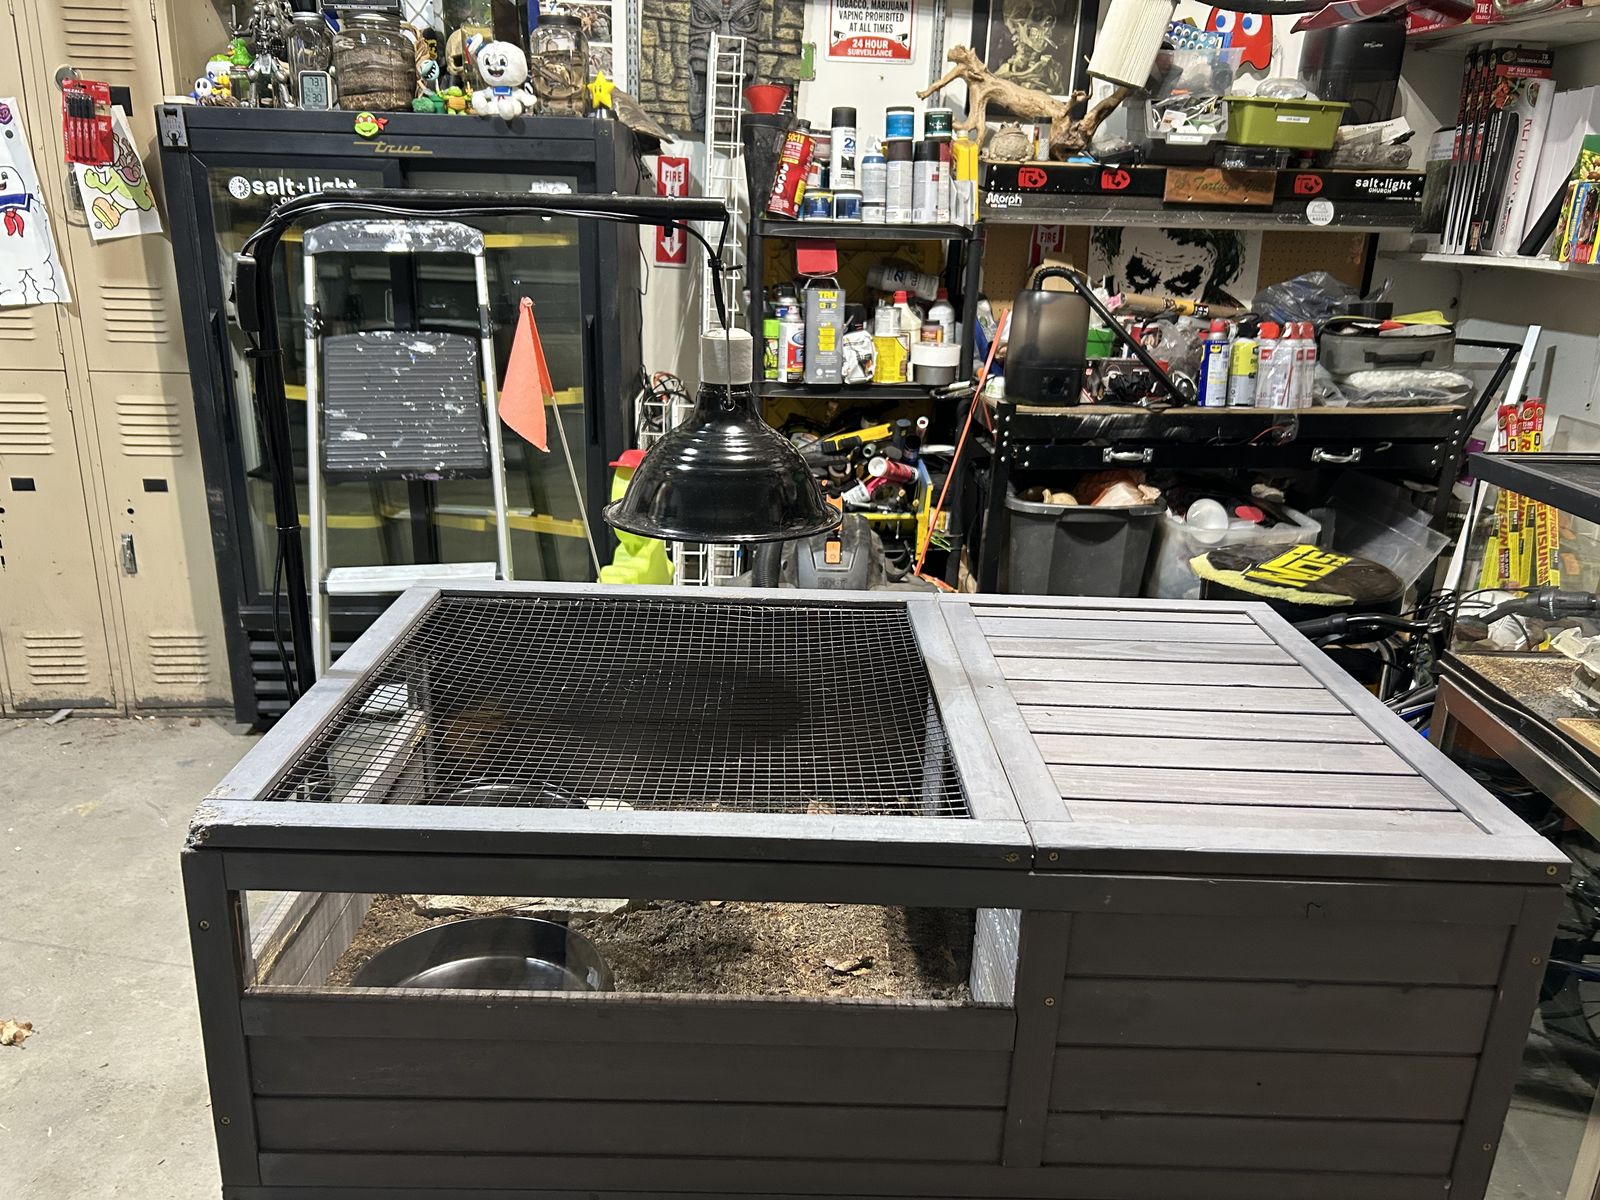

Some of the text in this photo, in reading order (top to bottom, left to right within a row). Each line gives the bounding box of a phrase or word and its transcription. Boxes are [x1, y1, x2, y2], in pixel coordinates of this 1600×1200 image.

[836, 0, 909, 11] TOBACCO, MARIJUANA
[839, 10, 905, 22] VAPING PROHIBITED
[849, 22, 894, 33] AT ALL TIMES
[852, 39, 889, 49] 24 HOUR
[847, 48, 893, 57] SURVEILLANCE
[665, 171, 682, 181] FIRE
[986, 193, 1022, 206] Morph
[1041, 231, 1057, 243] FIRE
[1537, 502, 1549, 570] EPTISUN
